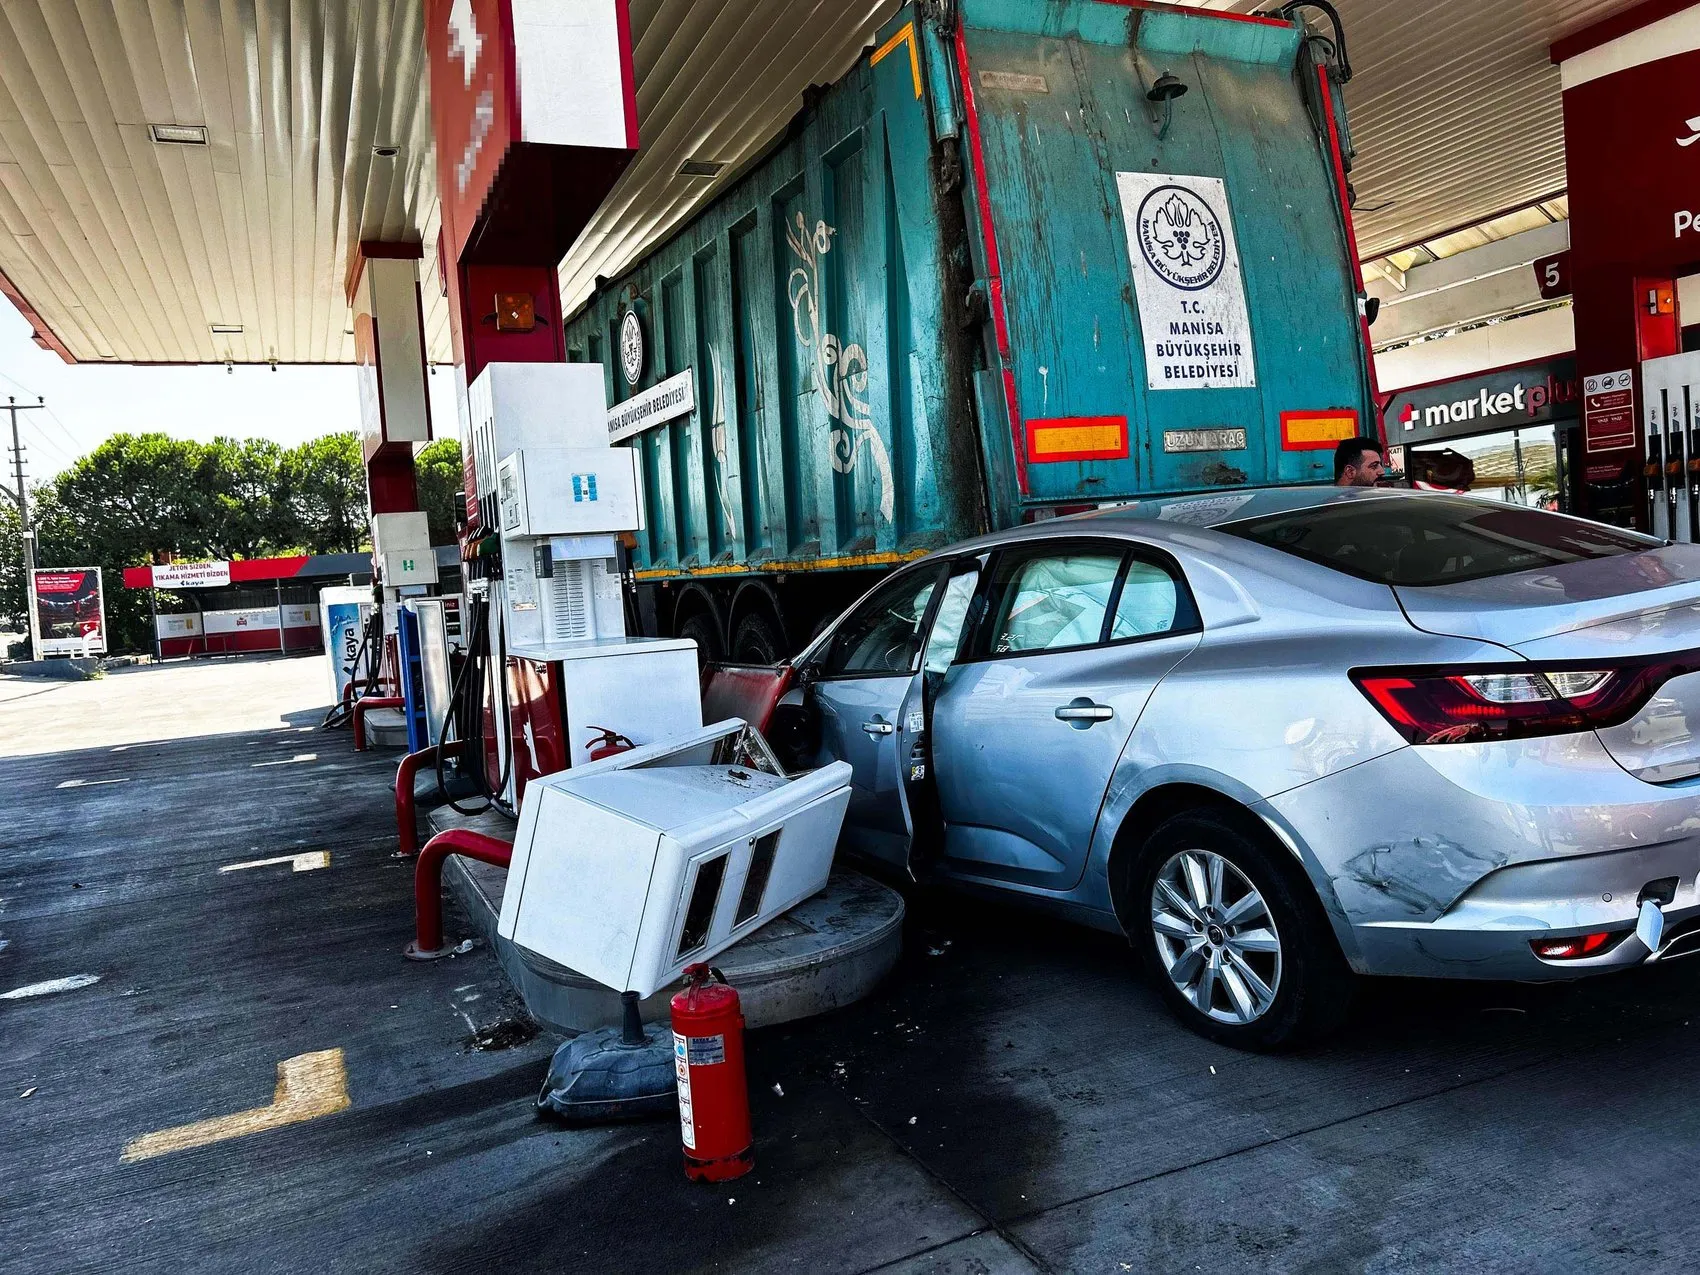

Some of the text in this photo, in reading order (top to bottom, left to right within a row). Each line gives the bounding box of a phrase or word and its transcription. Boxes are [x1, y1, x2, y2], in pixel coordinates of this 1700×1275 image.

[1143, 218, 1221, 286] MANİSA BÜYÜKŞEHİR BELEDİYESİ
[1545, 262, 1560, 287] 5
[1180, 300, 1205, 315] T.C.
[1169, 319, 1224, 335] MANİSA
[1156, 340, 1242, 360] BÜYÜKŞEHİR
[1164, 361, 1239, 380] BELEDİYESİ
[621, 399, 653, 427] BÜYÜKŞEHİR
[652, 383, 685, 413] BELEDİYESİ
[1166, 431, 1207, 447] UZUN
[155, 573, 180, 581] YIKAMA
[181, 571, 206, 580] HİZMETİ
[344, 628, 359, 662] kaya
